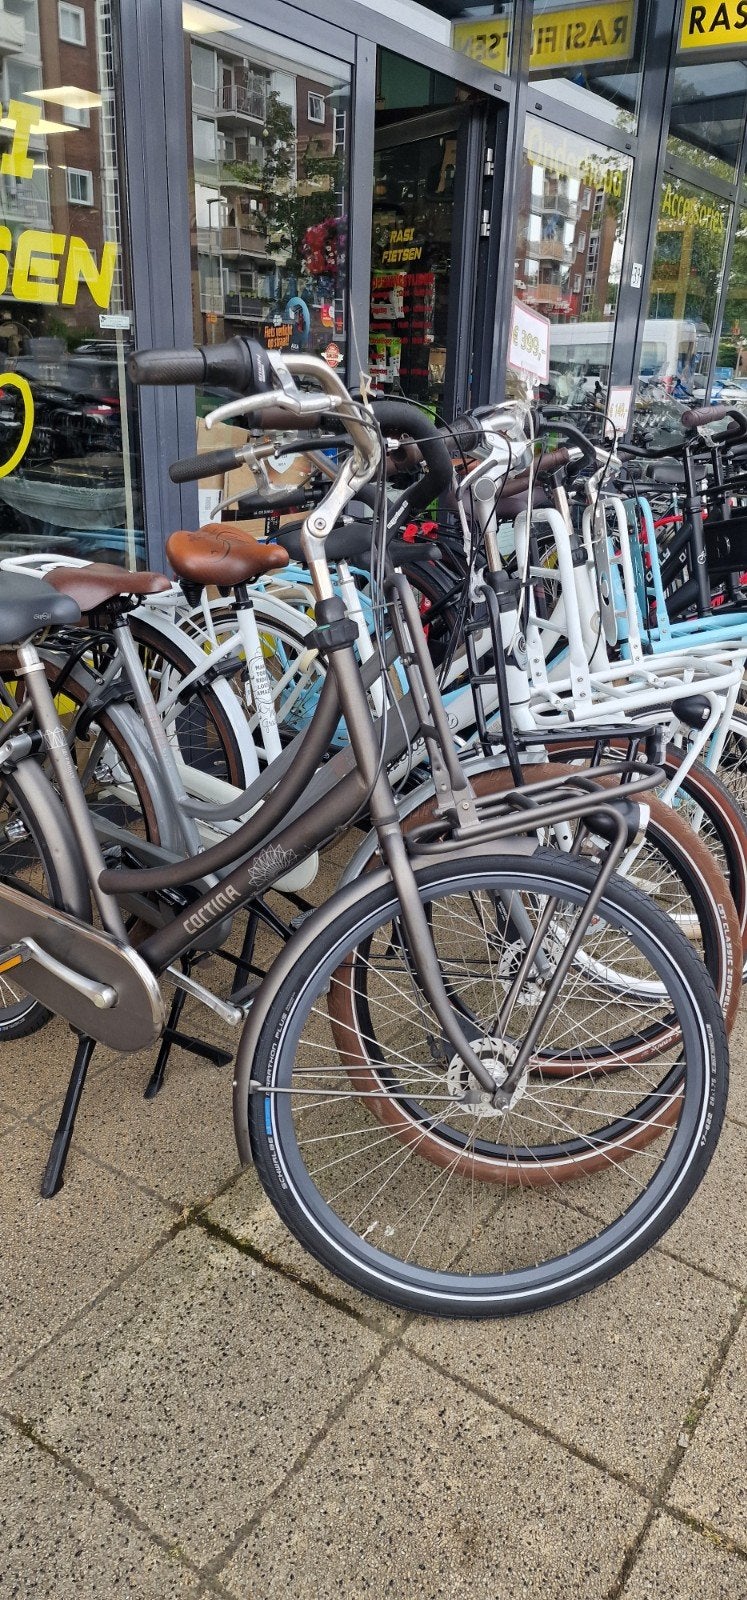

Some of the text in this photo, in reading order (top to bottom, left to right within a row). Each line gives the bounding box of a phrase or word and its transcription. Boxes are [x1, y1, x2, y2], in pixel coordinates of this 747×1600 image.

[688, 0, 747, 35] RAS
[0, 98, 42, 179] I
[382, 247, 422, 264] FIETSEN
[390, 227, 415, 243] RASI
[0, 225, 118, 309] EN
[183, 884, 242, 935] CORTINA
[717, 903, 727, 922] CST
[722, 922, 733, 966] CLASSIC
[274, 1012, 288, 1039] PLUS
[266, 1136, 289, 1190] SCHWALBE
